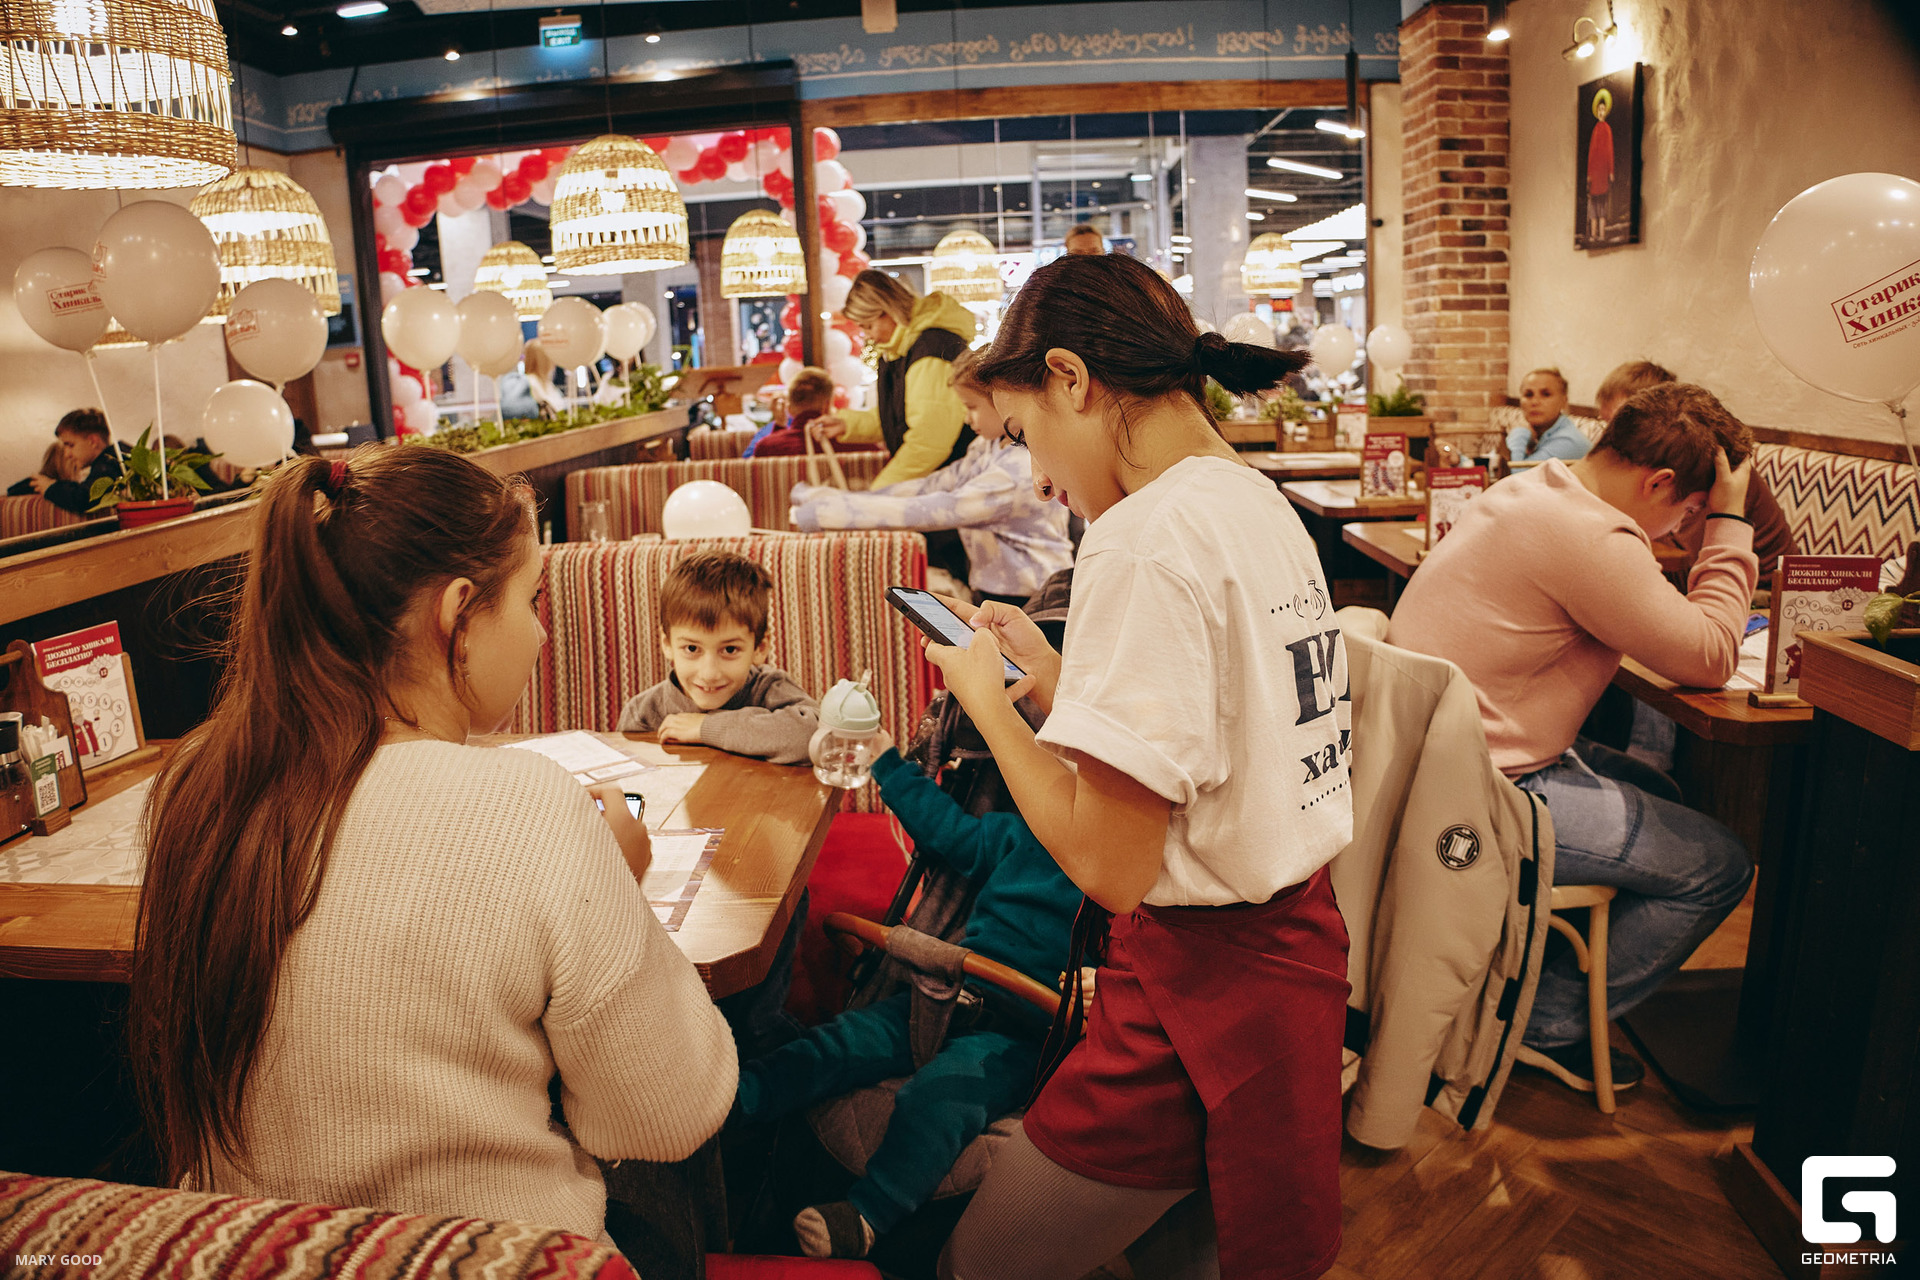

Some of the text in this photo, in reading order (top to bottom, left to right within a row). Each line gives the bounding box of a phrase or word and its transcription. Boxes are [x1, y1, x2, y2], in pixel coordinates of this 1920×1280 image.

[50, 288, 87, 300] Старик
[1841, 272, 1920, 317] Старик
[1852, 339, 1868, 349] Сеть
[1788, 569, 1872, 579] ДЮЖИНУ ХИНКАЛИ
[44, 646, 81, 662] ДЮЖИНУ
[81, 636, 115, 651] ХИНКАЛИ
[46, 650, 93, 670] БЕСПЛАТНО!
